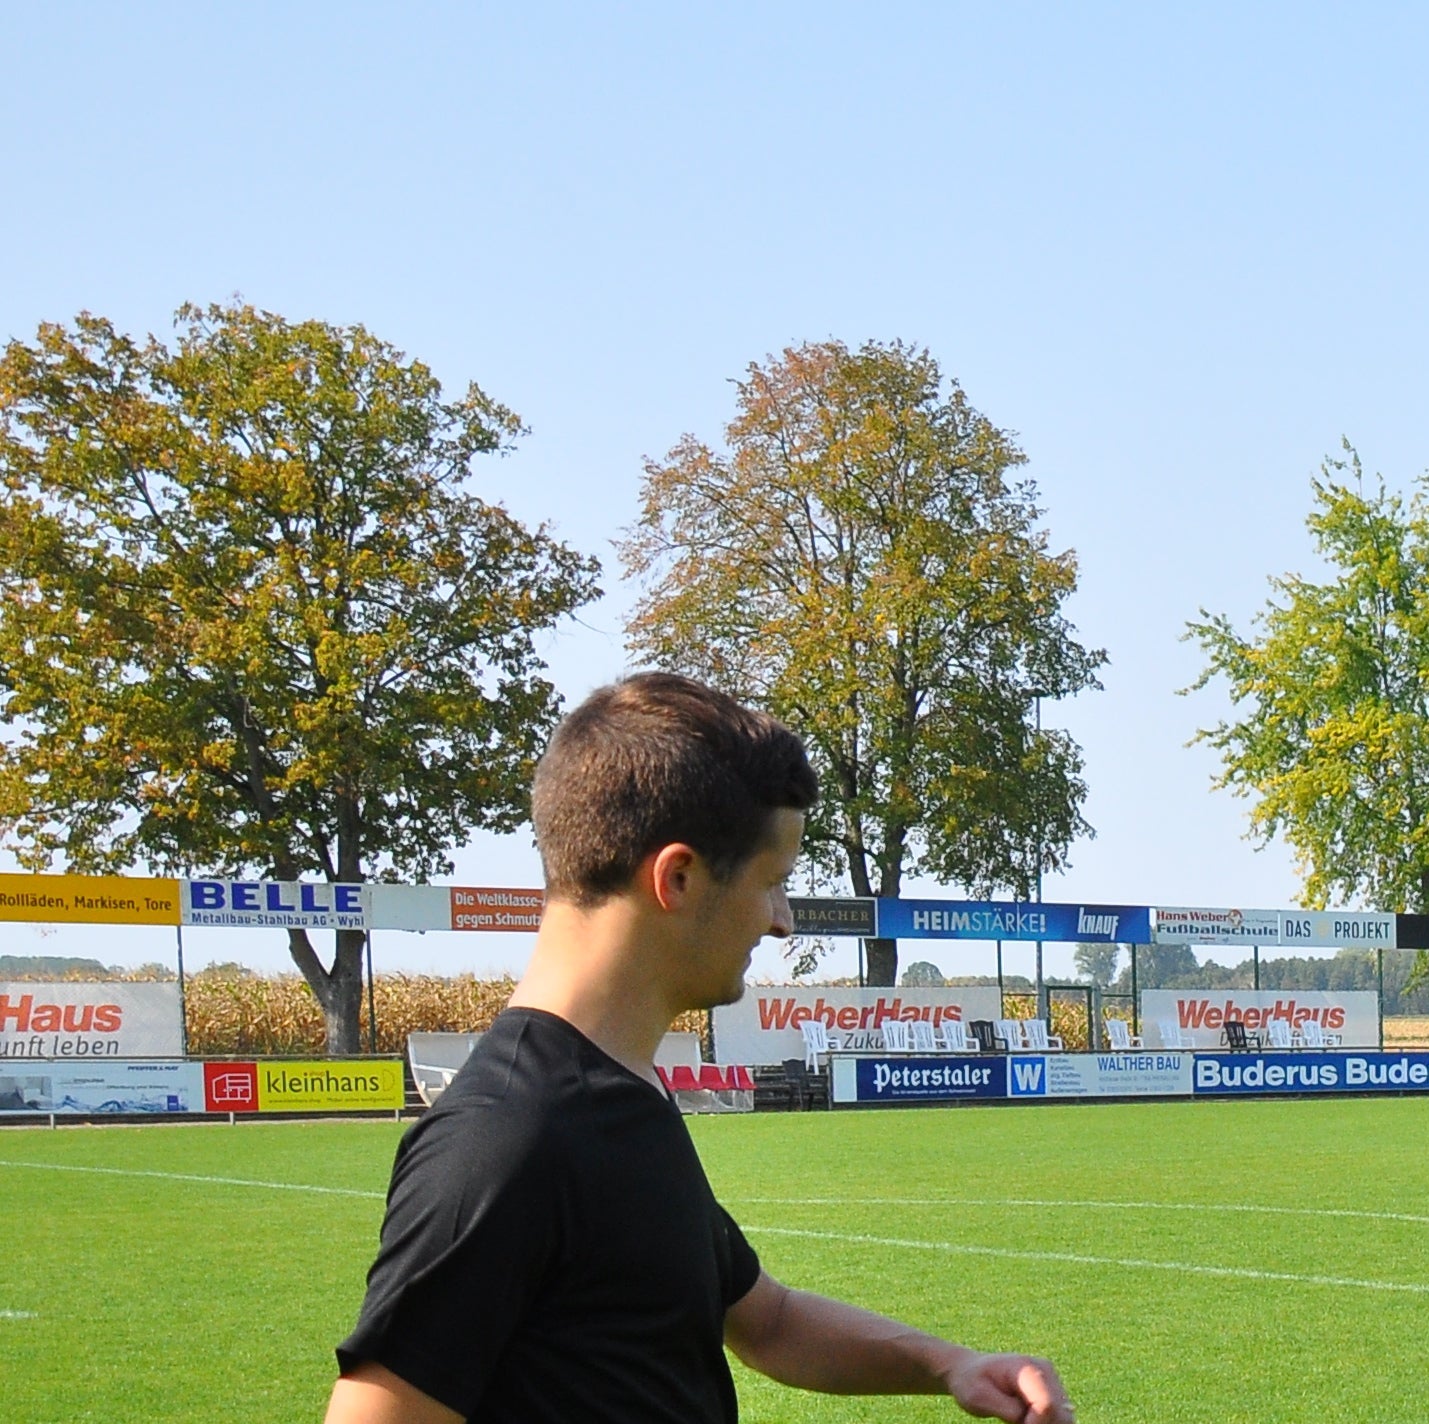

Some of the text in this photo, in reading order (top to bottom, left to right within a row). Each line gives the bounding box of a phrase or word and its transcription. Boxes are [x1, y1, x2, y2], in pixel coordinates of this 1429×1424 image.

[74, 896, 140, 912] Markisen,
[144, 897, 172, 911] Tore
[190, 881, 363, 913] BELLE
[455, 892, 474, 906] Die
[191, 912, 365, 928] Metallbau-Stahlbau AG Wyhl
[456, 913, 493, 928] gegen
[913, 908, 1046, 933] HEIMSTÄRKE!
[1156, 910, 1187, 921] Hans
[1189, 911, 1229, 922] Weber
[1157, 923, 1278, 937] Fußballschule
[1285, 920, 1390, 939] DAS PROJEKT
[757, 998, 962, 1030] WeberHaus
[52, 1035, 119, 1056] leben
[1097, 1056, 1181, 1071] WALTHER BAU
[1196, 1060, 1338, 1087] Buderus
[267, 1070, 380, 1093] kleinhans
[873, 1063, 992, 1093] Peterstaler
[1014, 1064, 1042, 1091] W
